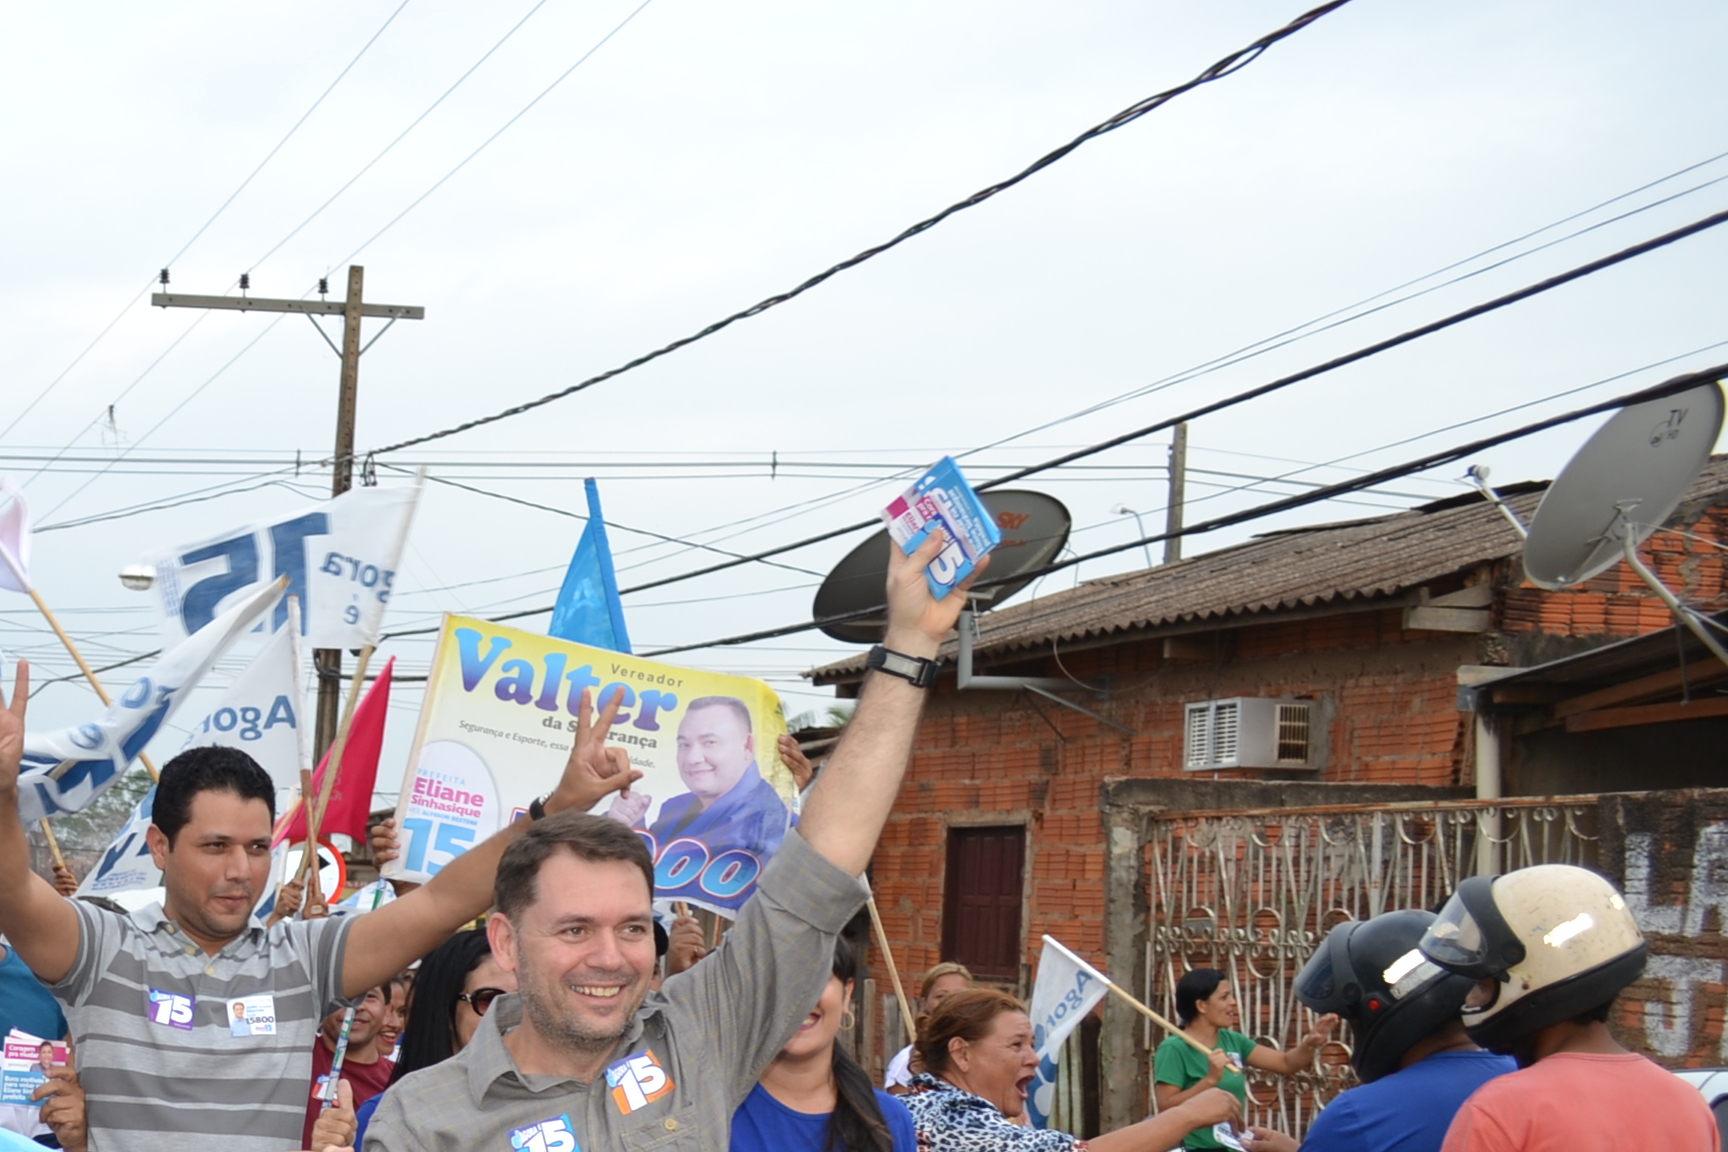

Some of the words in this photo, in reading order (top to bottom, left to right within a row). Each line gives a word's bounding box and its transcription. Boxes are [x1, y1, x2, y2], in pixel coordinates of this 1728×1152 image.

[454, 627, 678, 733] Valter
[611, 663, 684, 689] Vereador
[542, 716, 563, 732] da
[416, 767, 467, 787] PREFEITA
[413, 776, 485, 808] Eliane
[410, 794, 482, 819] Sinhasique
[402, 817, 477, 876] 15
[155, 995, 193, 1025] 15
[8, 1045, 36, 1053] Coragem
[617, 1055, 666, 1111] 15
